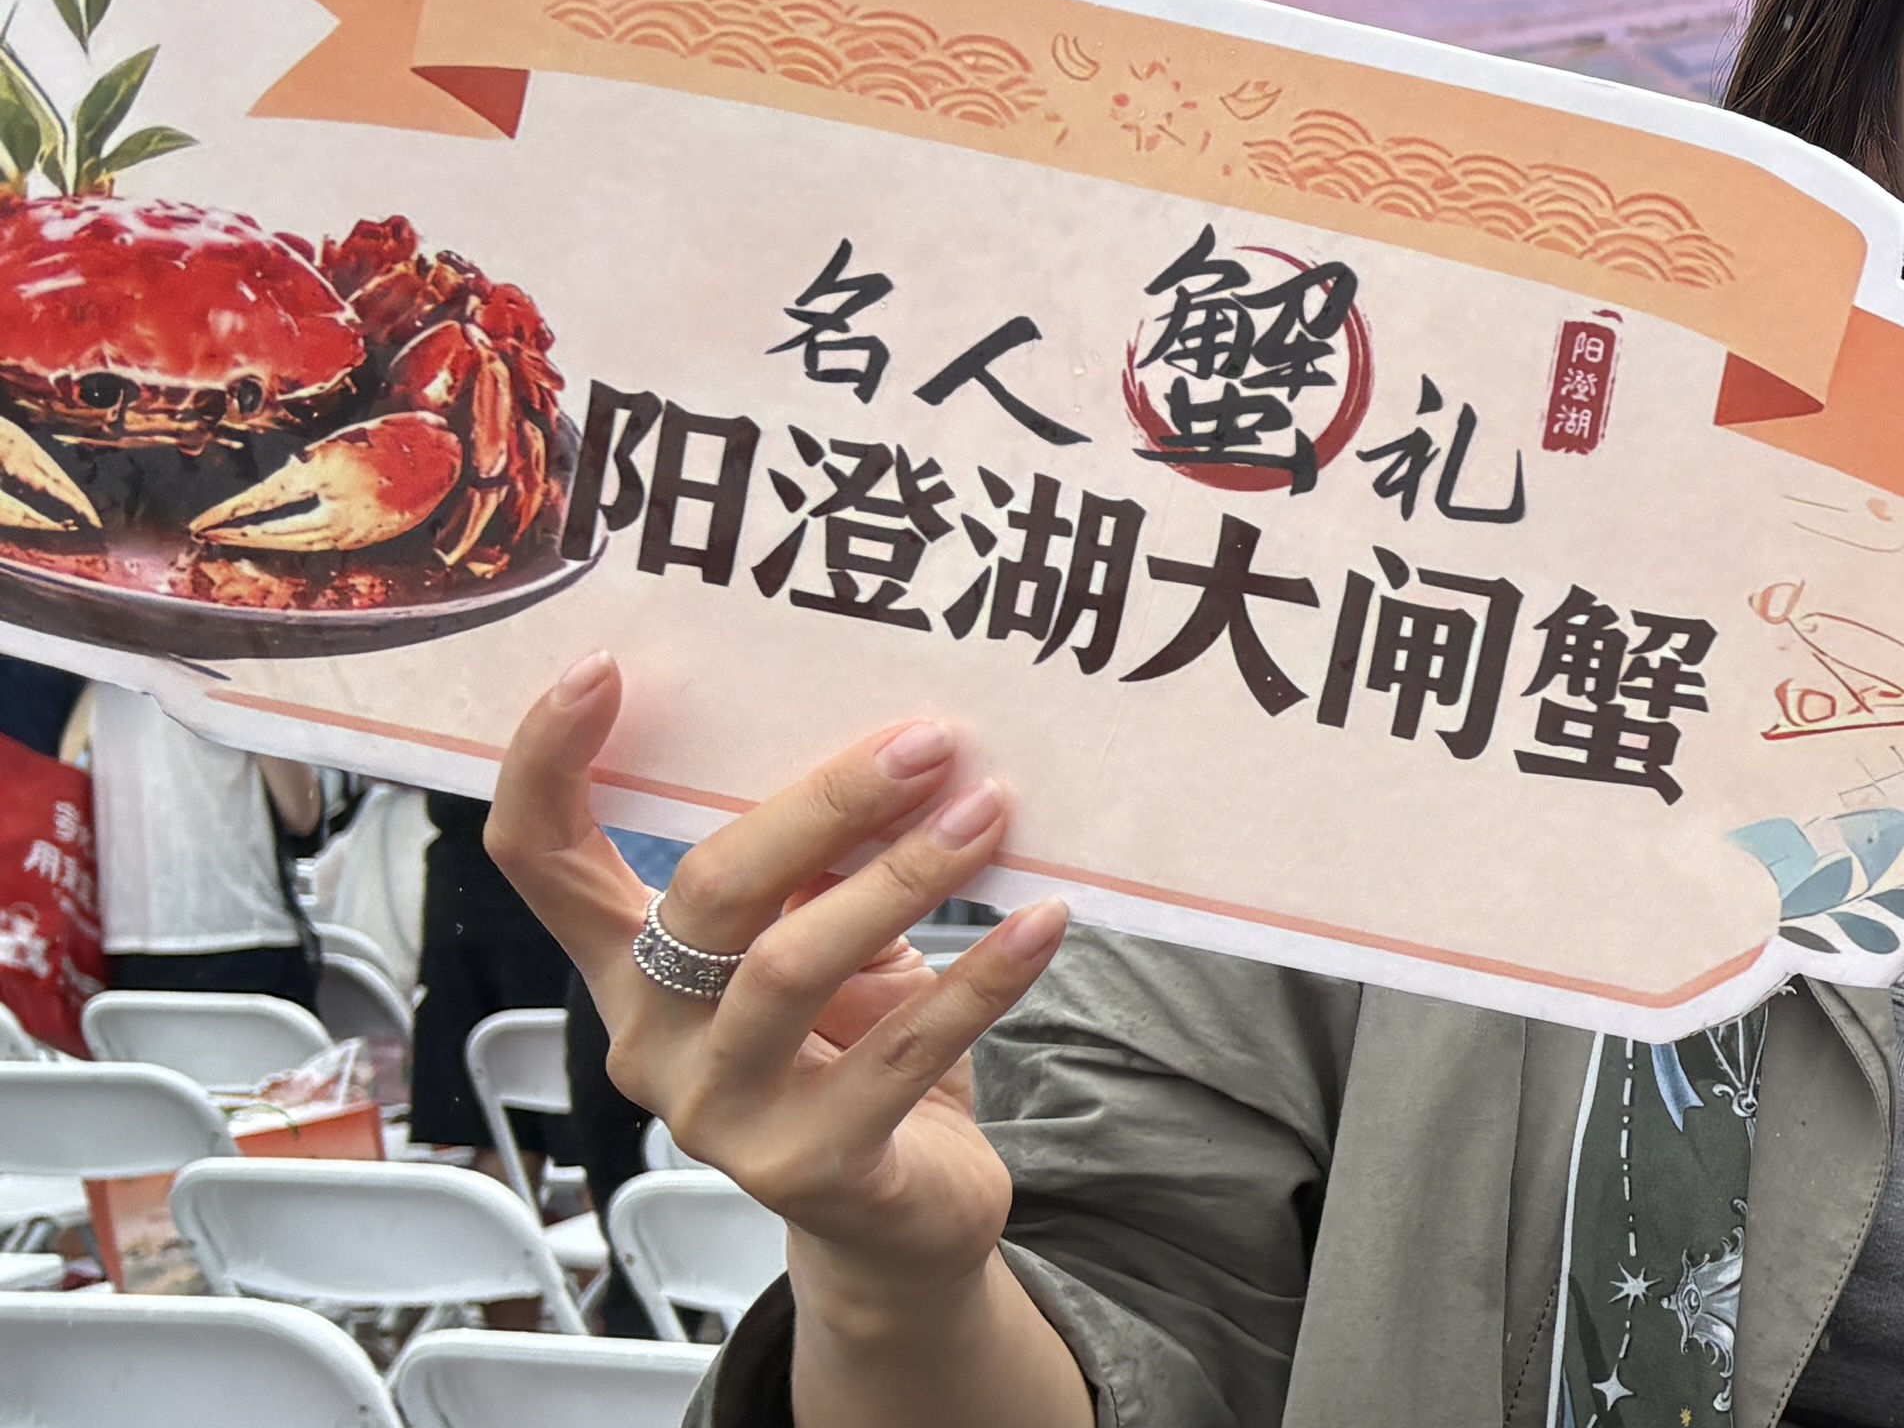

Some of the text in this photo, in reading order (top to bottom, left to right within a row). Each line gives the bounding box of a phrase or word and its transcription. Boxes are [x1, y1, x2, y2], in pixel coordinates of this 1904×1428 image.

[765, 224, 1525, 523] 名人蟹礼
[1553, 332, 1605, 439] 阳澄湖
[561, 380, 1717, 806] 阳澄湖大闸蟹
